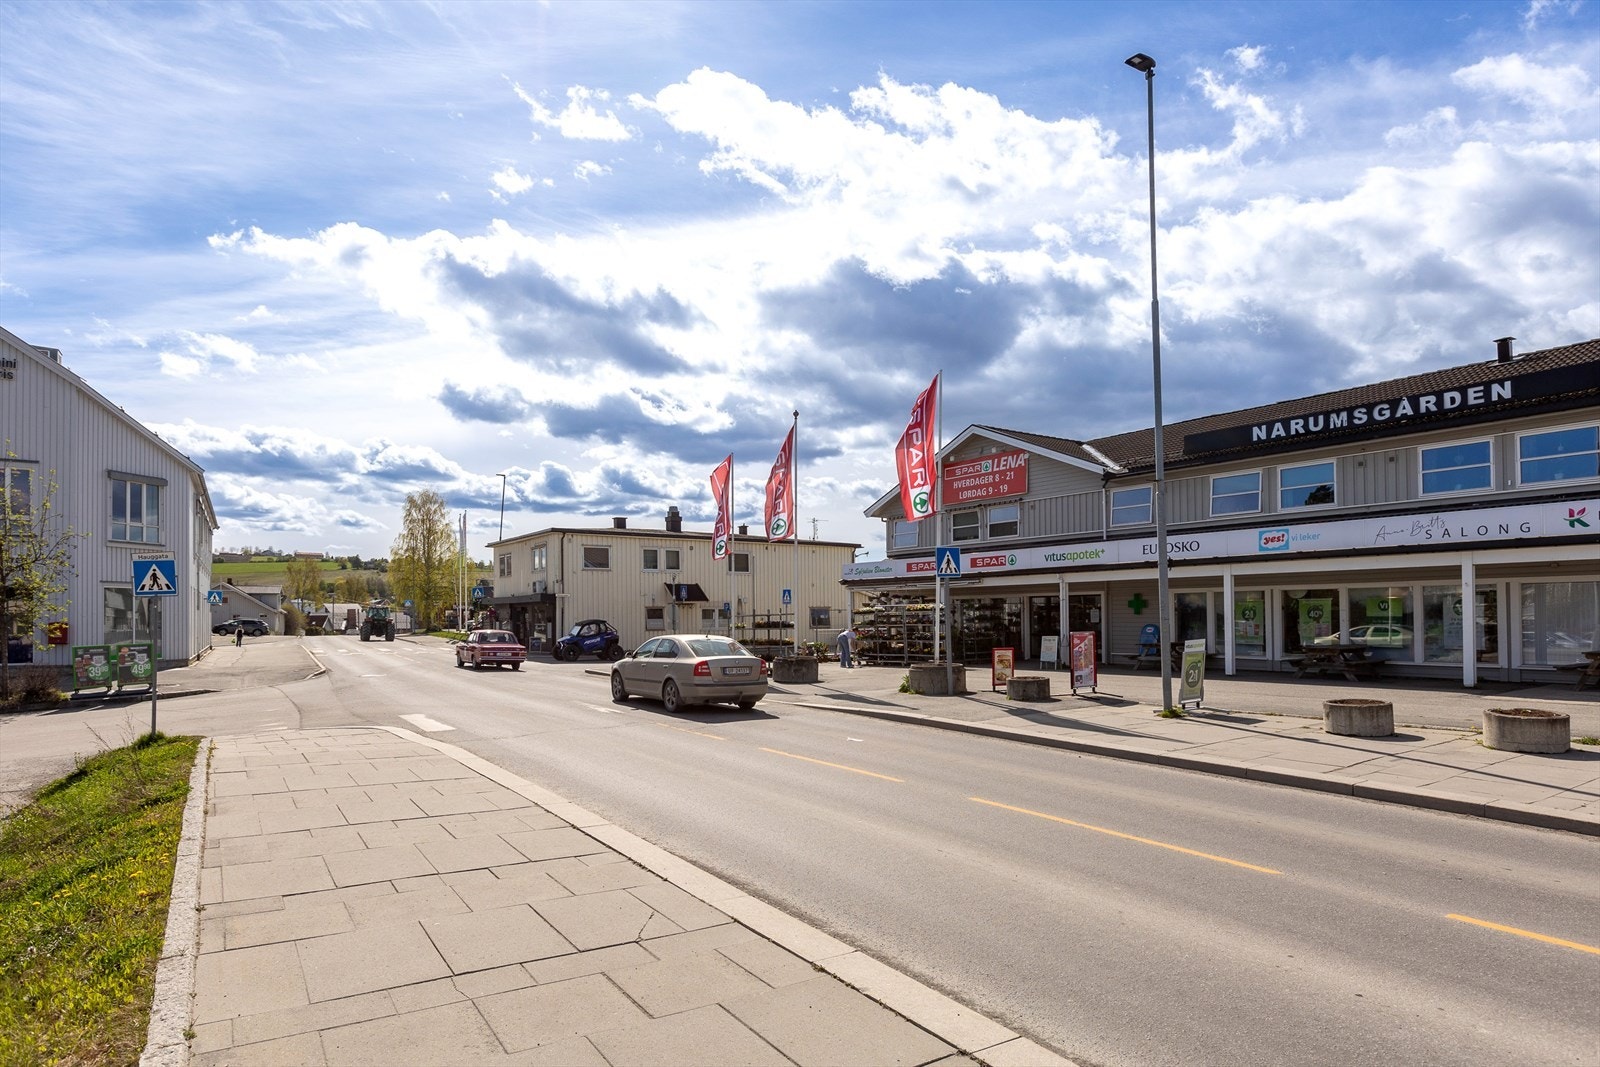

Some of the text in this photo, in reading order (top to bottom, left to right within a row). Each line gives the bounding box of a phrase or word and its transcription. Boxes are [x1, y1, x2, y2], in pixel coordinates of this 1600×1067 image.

[1252, 380, 1512, 442] NARUMSGÅRDEN
[955, 453, 1025, 476] SPAR LENA
[953, 475, 993, 489] HVERDAGER
[994, 474, 1000, 482] 8
[1006, 471, 1014, 480] 21
[959, 487, 987, 499] LØRDAG
[988, 486, 993, 495] 9
[999, 484, 1008, 493] 19
[1425, 521, 1532, 541] SALONG
[1263, 532, 1321, 546] yes! vi leker
[1142, 540, 1200, 555] EUOSKO
[911, 562, 937, 571] SPAR
[976, 556, 1006, 567] SPAR
